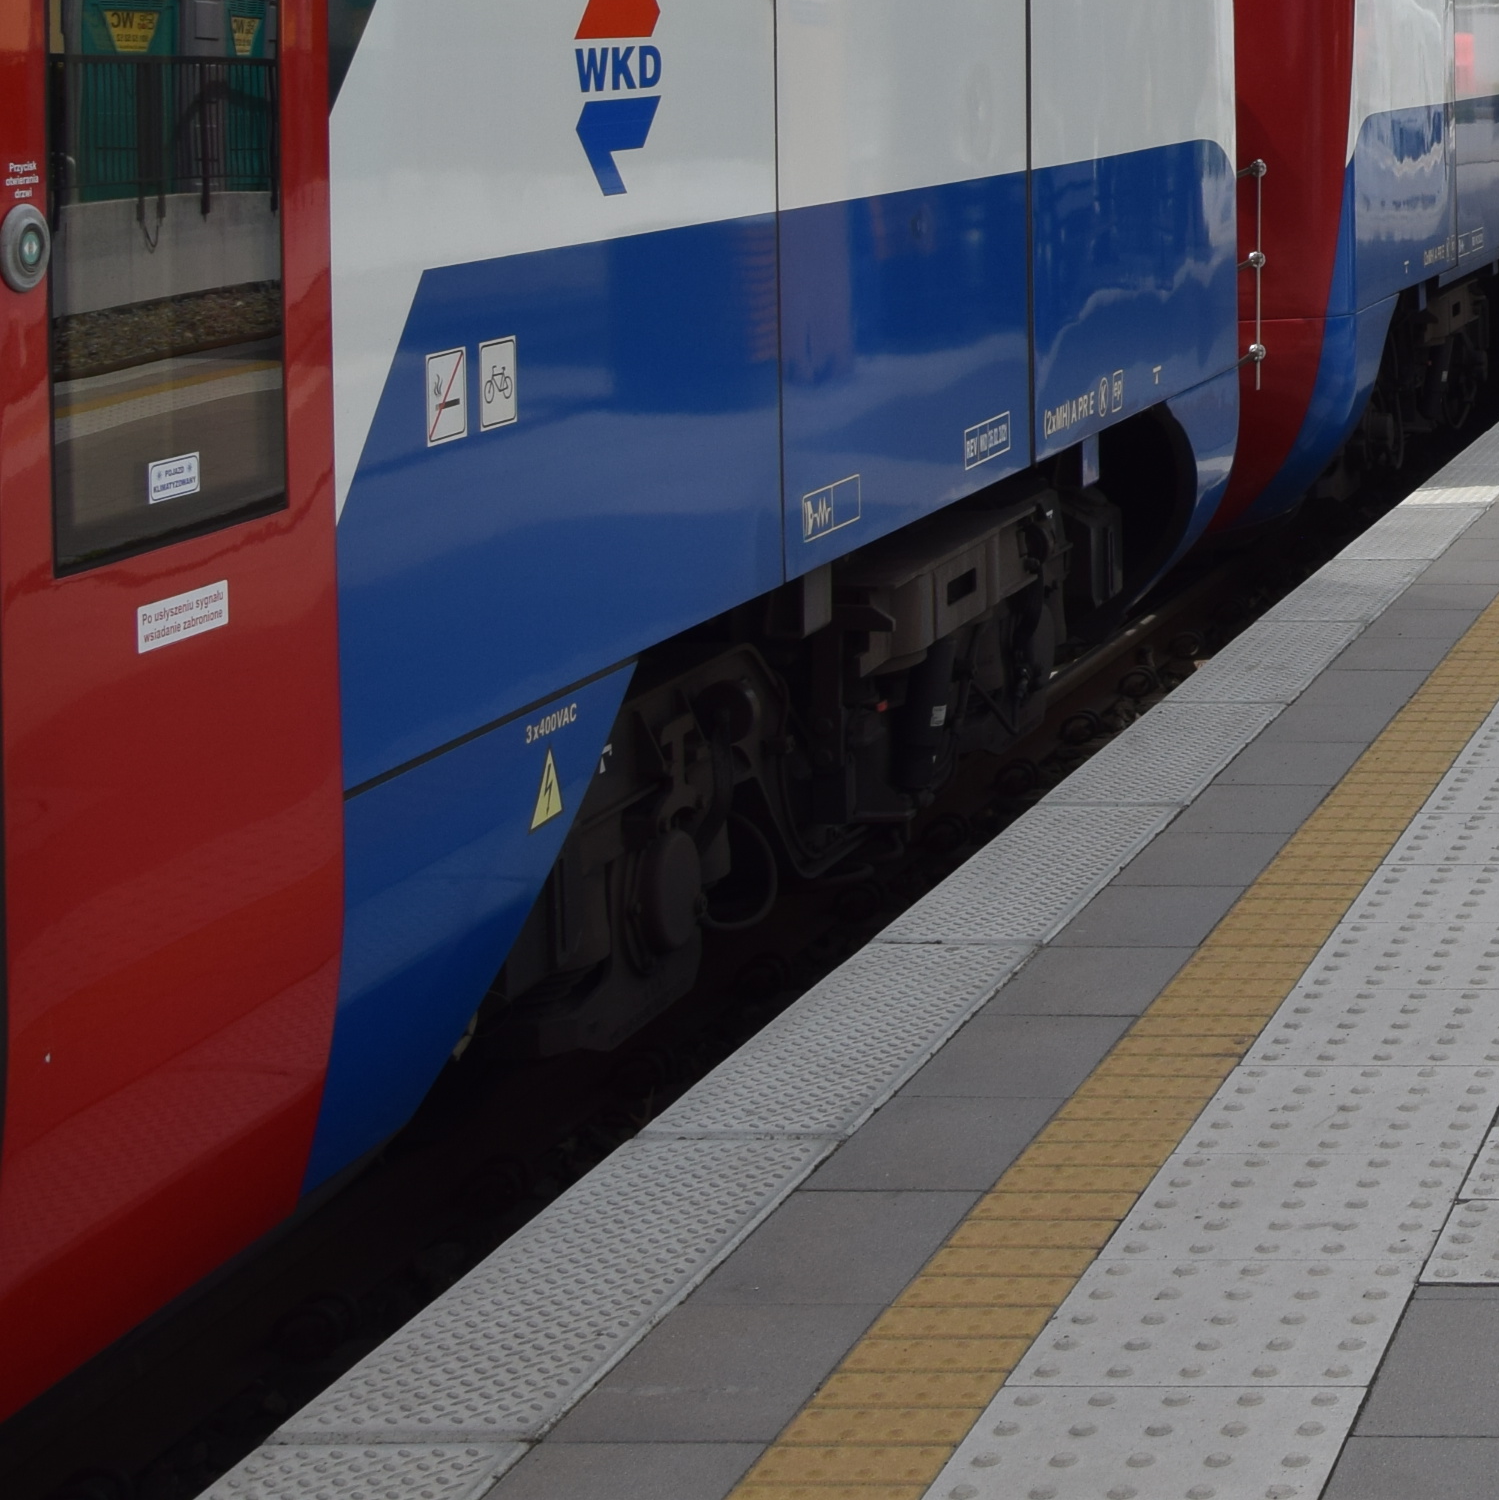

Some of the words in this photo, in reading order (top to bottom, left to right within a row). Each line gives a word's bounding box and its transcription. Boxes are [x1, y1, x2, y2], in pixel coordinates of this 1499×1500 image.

[575, 45, 662, 93] WKD
[142, 613, 152, 626] Po
[154, 599, 194, 621] usłyszeniu
[195, 590, 224, 610] sygnału
[143, 621, 181, 643] wsiadanie
[183, 609, 223, 630] zabronione
